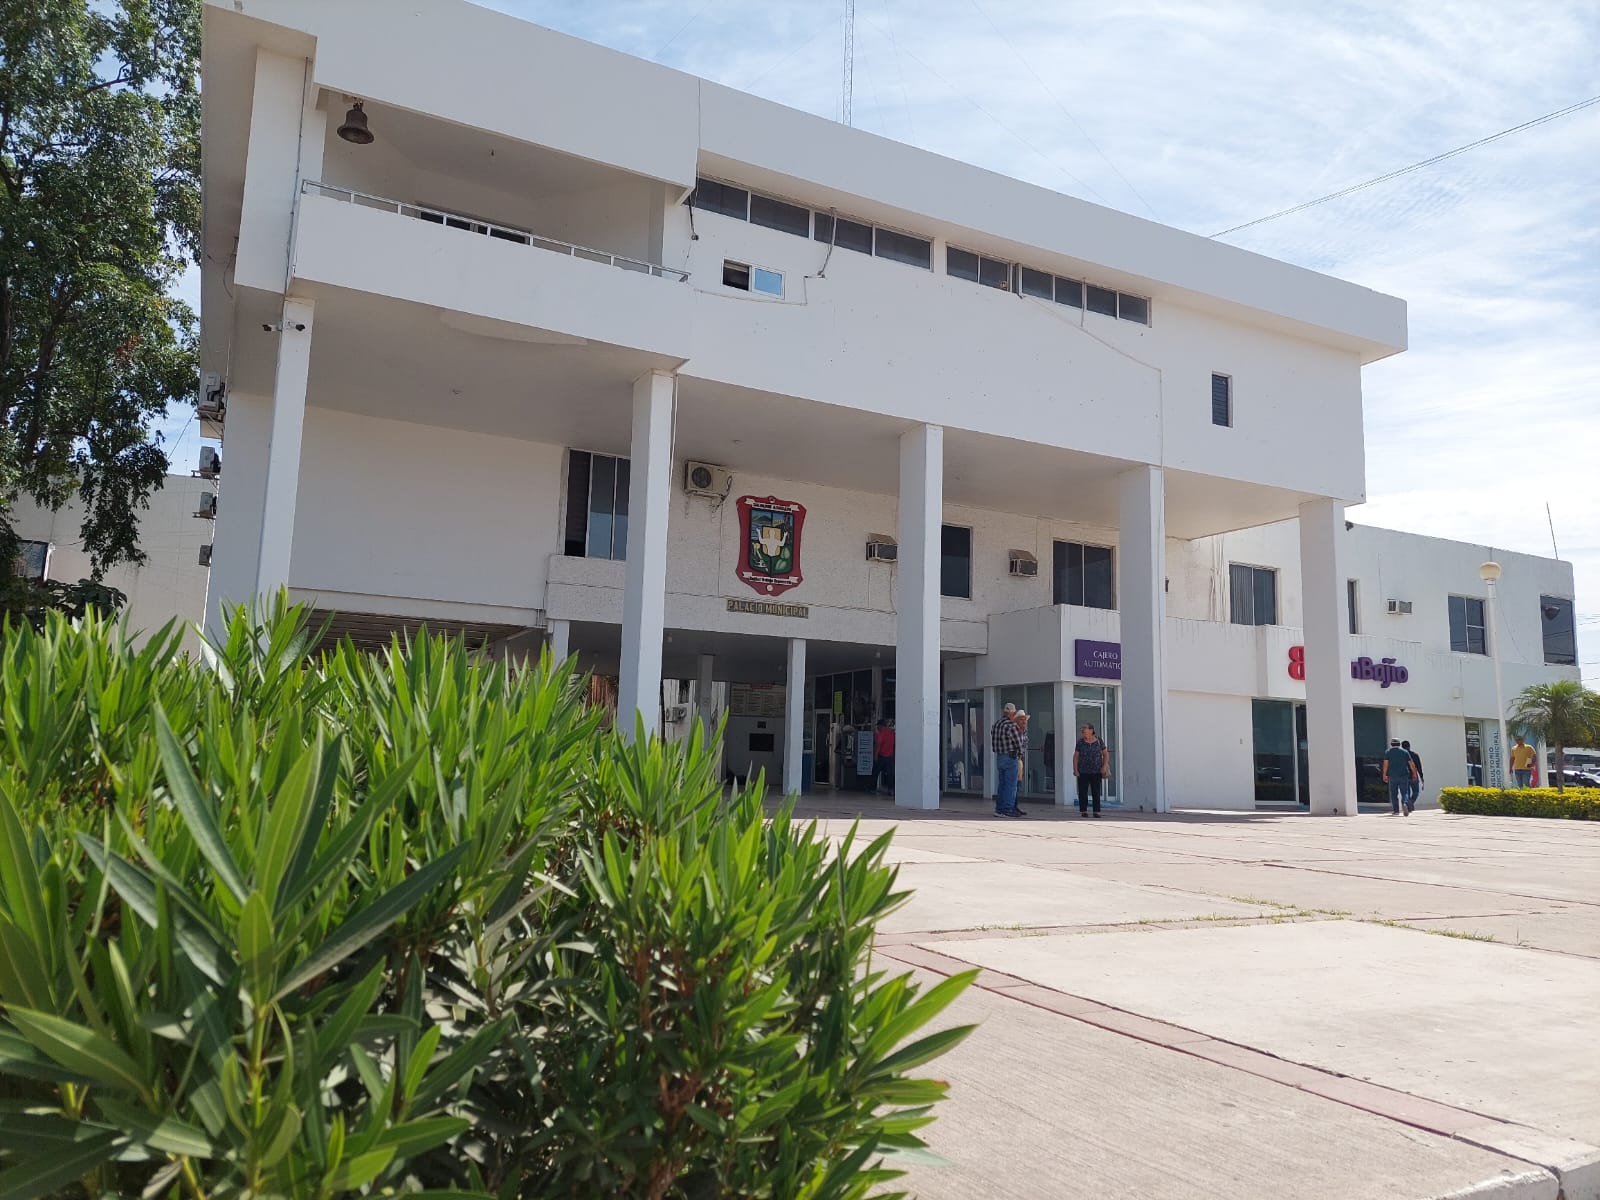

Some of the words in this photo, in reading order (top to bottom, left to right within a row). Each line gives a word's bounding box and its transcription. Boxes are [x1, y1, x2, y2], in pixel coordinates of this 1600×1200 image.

[727, 600, 763, 614] PALACIO
[765, 603, 807, 618] MUNICIPAL
[1093, 650, 1118, 660] CAJERO
[1351, 656, 1409, 688] nBajío
